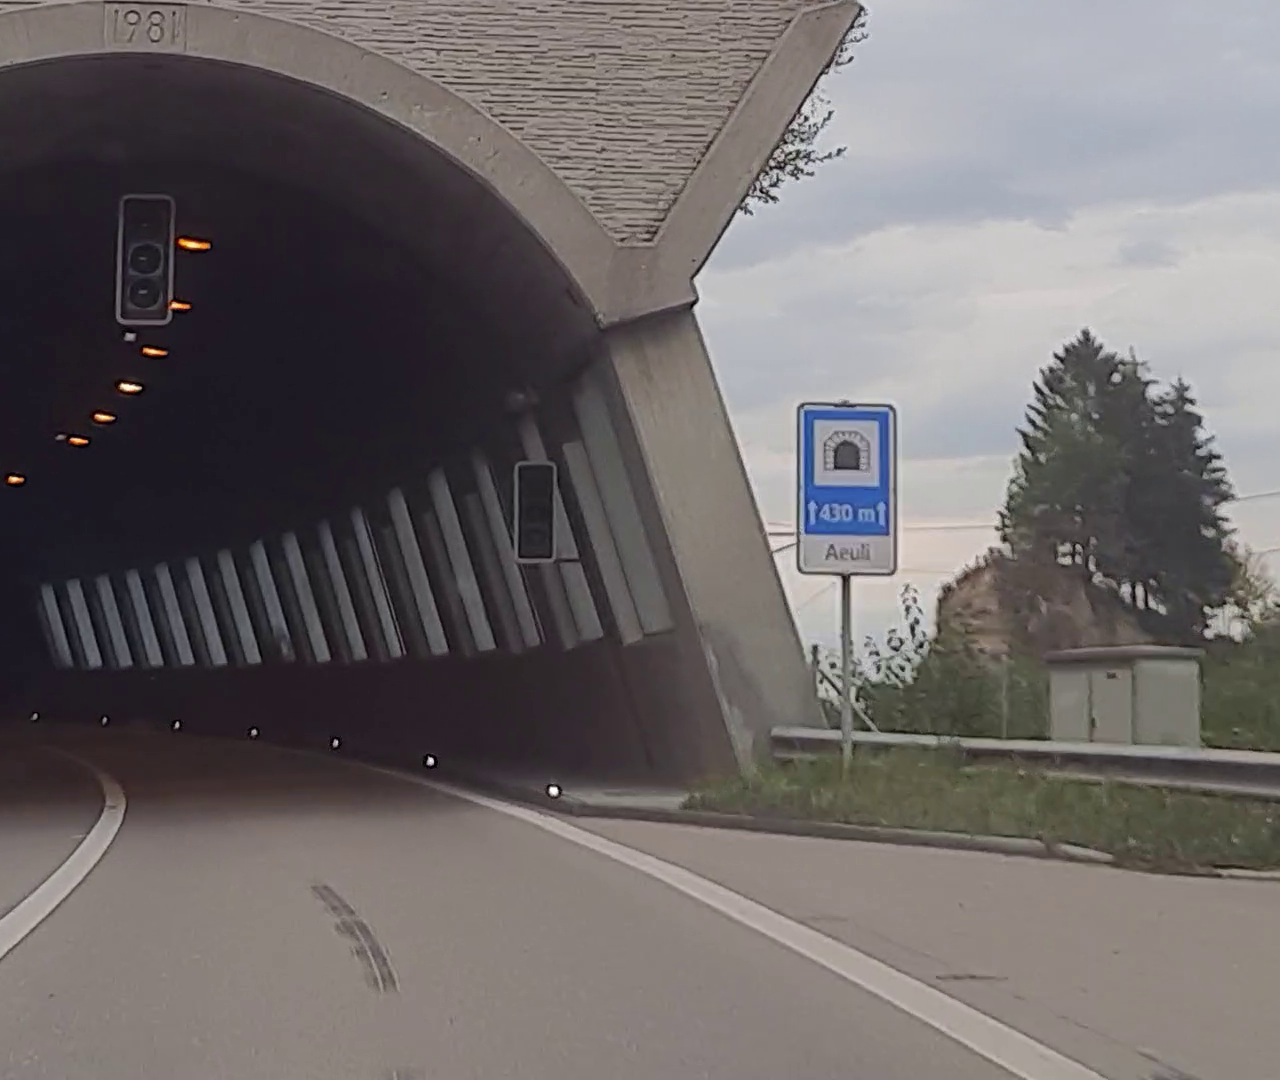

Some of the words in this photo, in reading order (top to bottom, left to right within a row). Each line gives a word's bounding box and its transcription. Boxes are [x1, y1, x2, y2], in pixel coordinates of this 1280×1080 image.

[113, 8, 178, 44] 1981
[819, 503, 853, 523] 430
[858, 508, 875, 522] m
[825, 543, 870, 561] Aeuli
